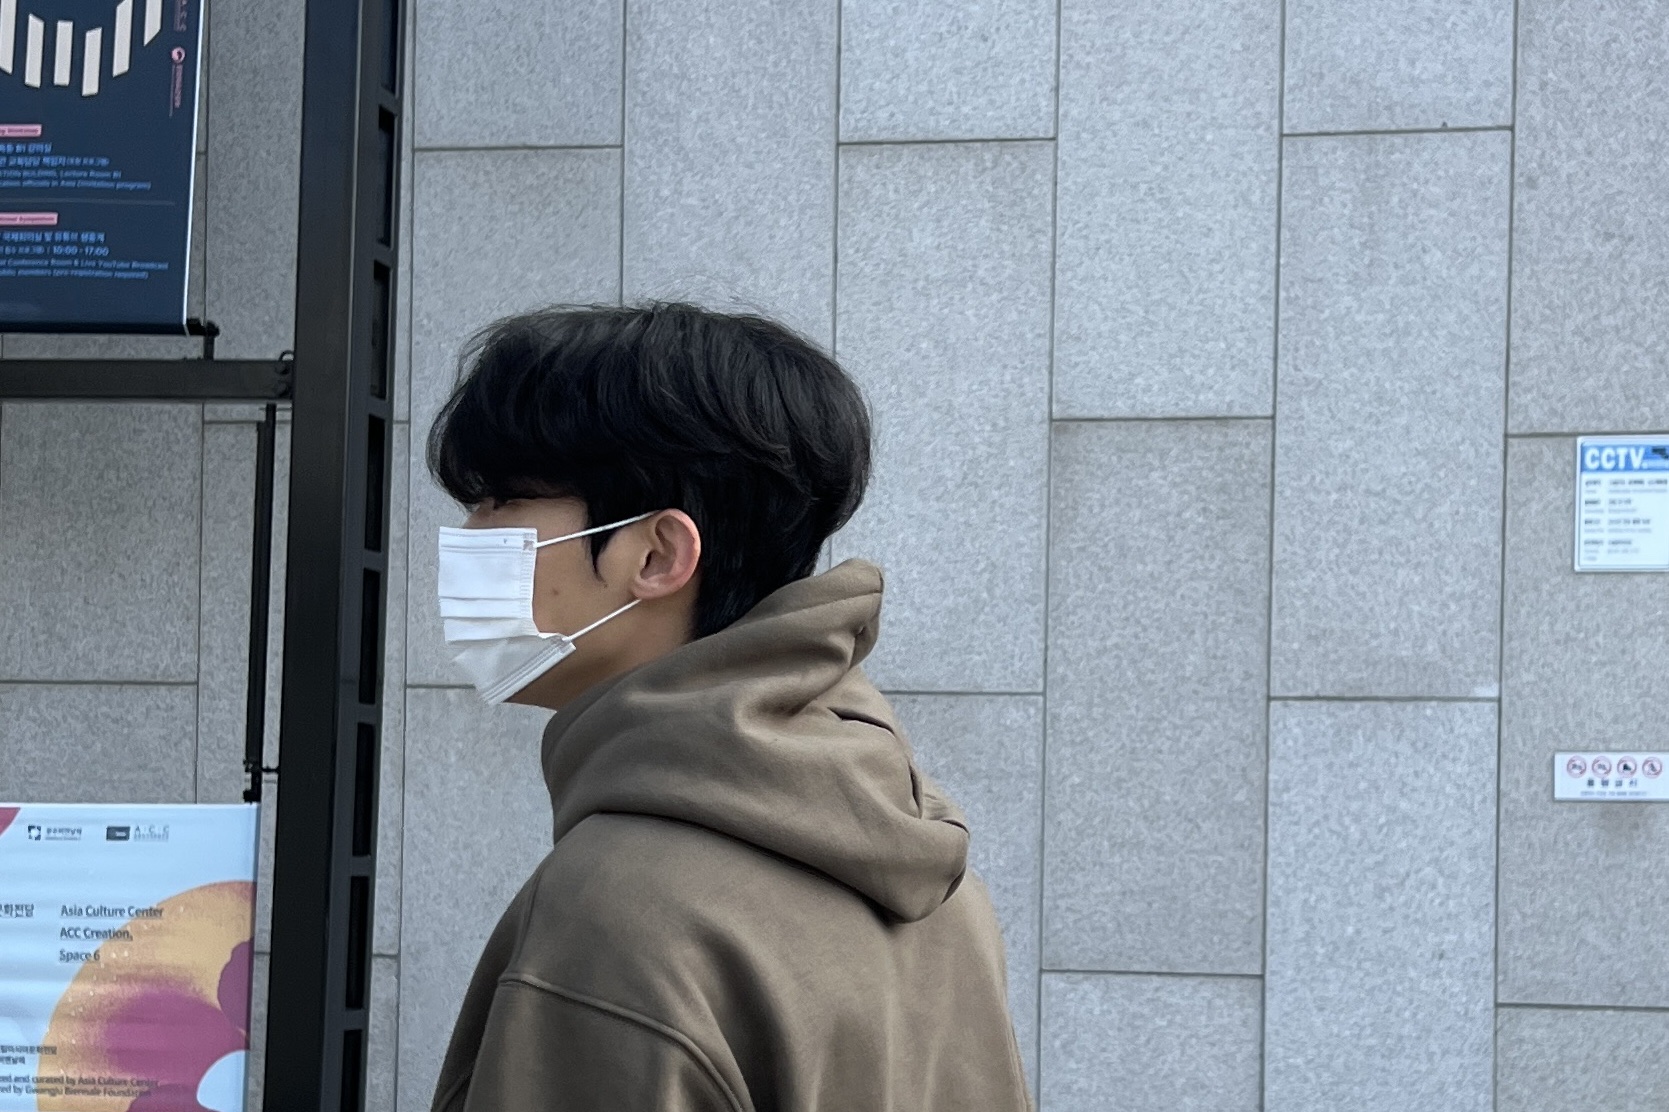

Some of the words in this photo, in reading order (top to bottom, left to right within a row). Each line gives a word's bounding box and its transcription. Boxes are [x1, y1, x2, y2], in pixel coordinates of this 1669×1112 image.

[1585, 447, 1645, 470] CCTV
[0, 903, 34, 918] 화전당
[61, 904, 83, 917] Asia
[86, 904, 126, 917] Culture
[128, 905, 164, 917] Center
[60, 927, 81, 939] ACC
[83, 927, 133, 941] Creation,
[59, 949, 92, 963] Space
[93, 950, 100, 961] 6
